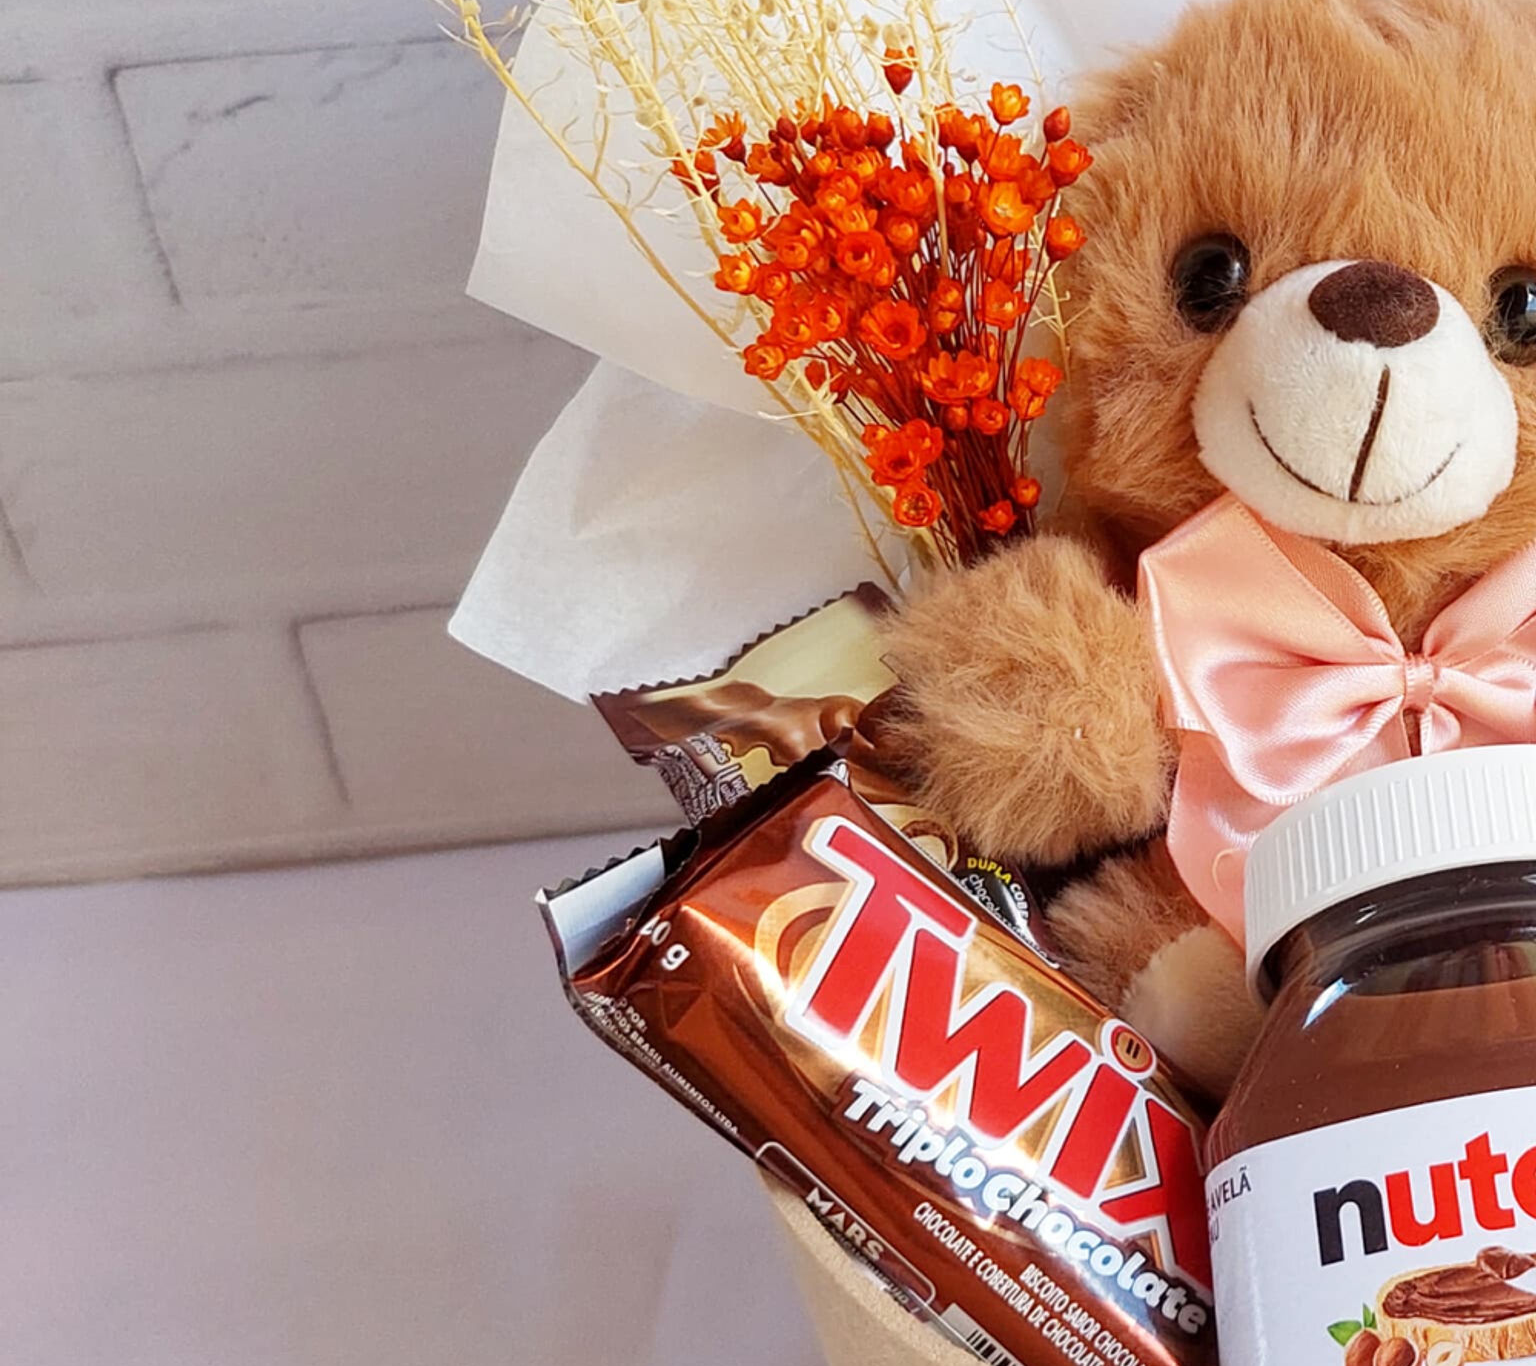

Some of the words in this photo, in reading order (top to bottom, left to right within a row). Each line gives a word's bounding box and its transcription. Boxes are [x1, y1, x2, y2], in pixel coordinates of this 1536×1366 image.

[967, 857, 1012, 884] DUPLA
[660, 943, 691, 971] g
[630, 1031, 664, 1065] BRASIL
[662, 1062, 716, 1114] ALIMENTOS
[805, 1186, 885, 1261] MARS
[845, 1078, 987, 1203] Triplo
[981, 1172, 1208, 1335] Chocolate
[913, 1201, 976, 1262] CHOCOLATE
[968, 1245, 983, 1267] E
[975, 1258, 1037, 1316] COBERTURA
[1019, 1263, 1071, 1317] BISCOITO
[1065, 1300, 1102, 1339] SABOR
[1028, 1306, 1049, 1327] DE
